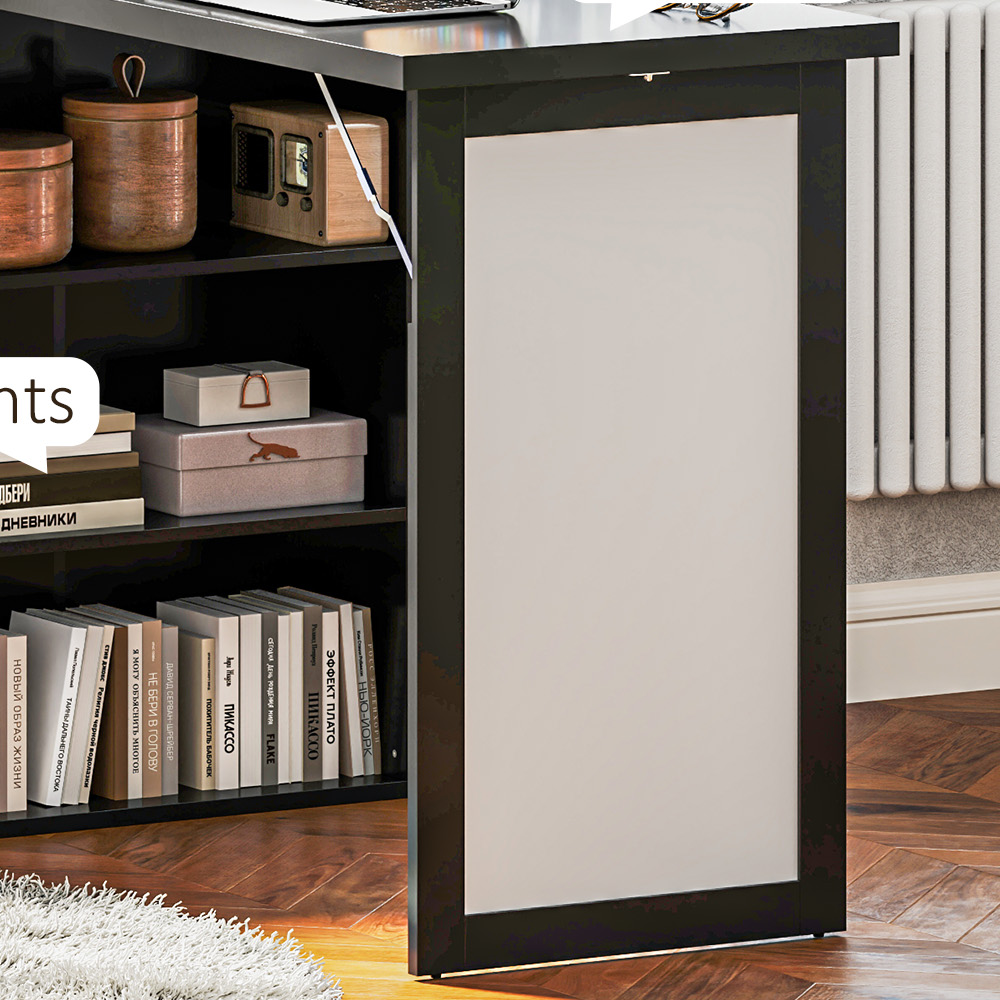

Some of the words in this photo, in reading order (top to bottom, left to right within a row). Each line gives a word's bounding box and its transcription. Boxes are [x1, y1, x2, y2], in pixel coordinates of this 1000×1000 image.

[1, 512, 76, 532] ДНЕВНИКИ
[13, 659, 23, 702] НОВЫЙ
[148, 672, 158, 687] НЕ
[165, 662, 174, 689] ДАВИД
[326, 650, 335, 699] ЭФФЕКТ
[94, 687, 105, 718] Религия
[148, 689, 158, 717] БЕРИ
[370, 676, 380, 744] ЭЛЛЕНХОРН
[13, 705, 22, 743] ОБРАЗ
[57, 722, 69, 759] ДАЛЬНЕГО
[90, 719, 99, 747] черной
[148, 719, 158, 727] В
[166, 690, 175, 761] СЕРВАН-ШРЕЙБЕР
[224, 704, 235, 754] ПИКАССО
[307, 692, 320, 761] ПИКАССО
[326, 703, 335, 745] ПЛАТО
[13, 745, 22, 789] ЖИЗНИ
[84, 748, 95, 788] водолазки
[148, 729, 158, 773] ГОЛОВУ
[267, 733, 275, 765] FLAKE
[52, 760, 63, 792] ВОСТОКА
